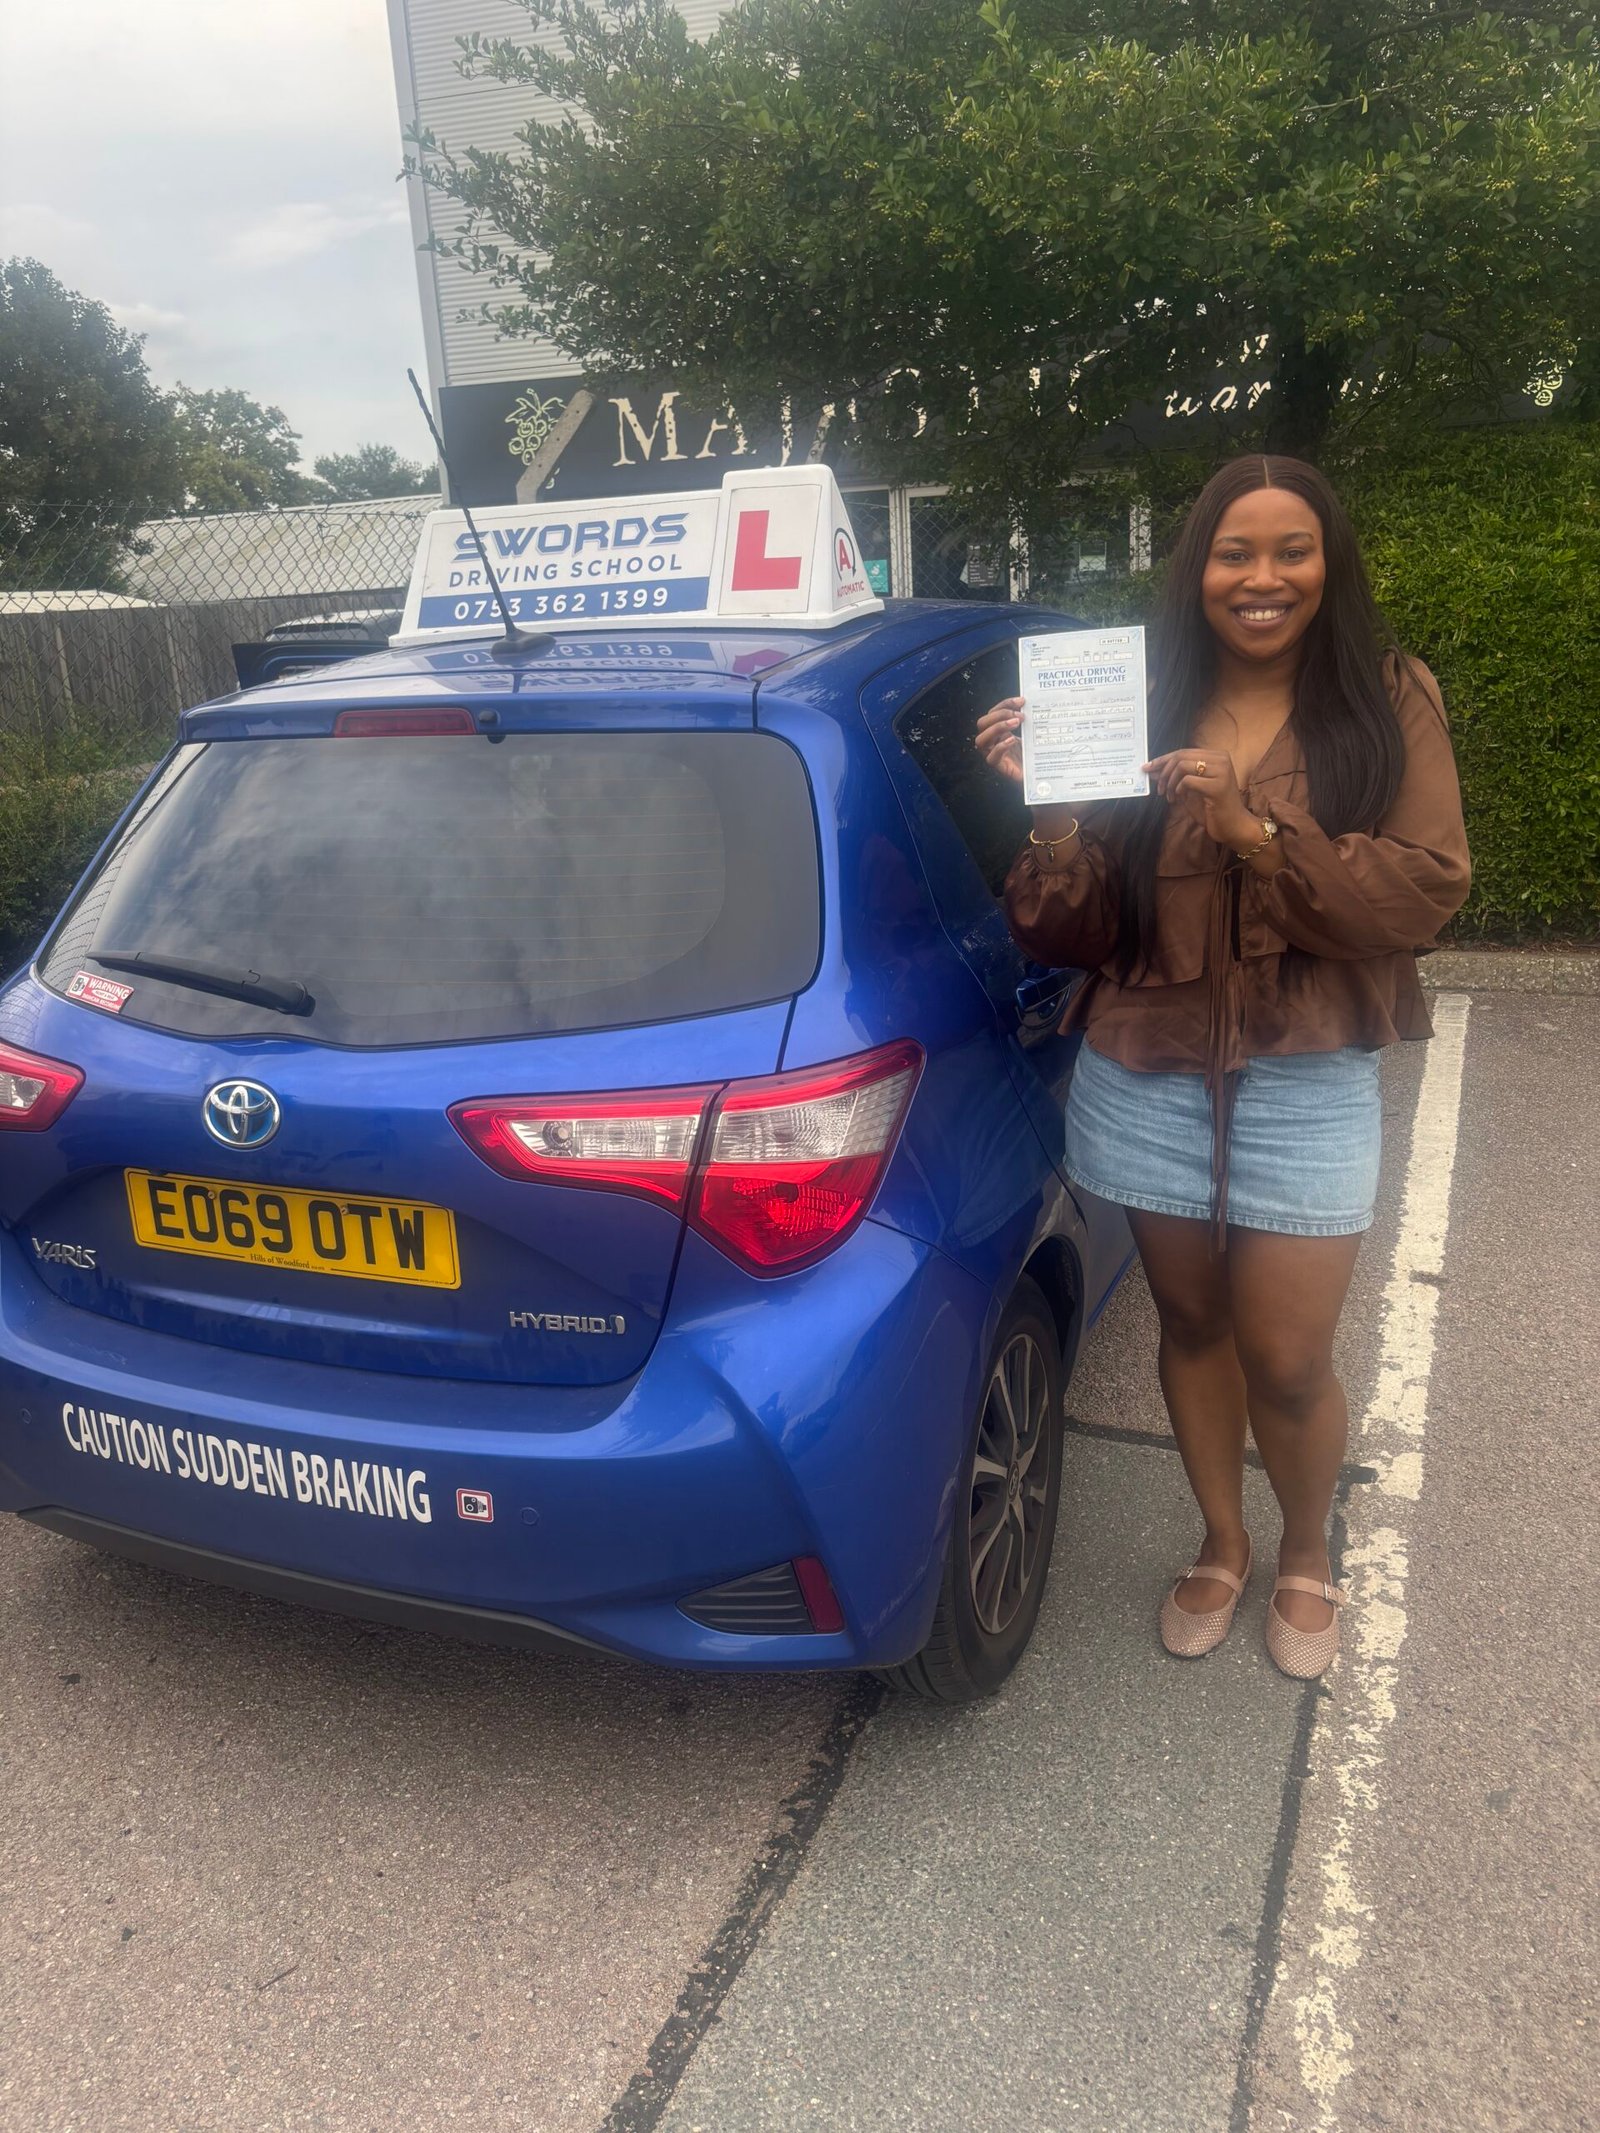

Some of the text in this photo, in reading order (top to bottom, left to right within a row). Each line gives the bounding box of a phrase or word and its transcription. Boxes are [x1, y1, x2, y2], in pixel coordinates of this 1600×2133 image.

[451, 513, 689, 563] SWORDS
[731, 509, 802, 591] L
[838, 538, 851, 571] A
[449, 554, 682, 588] DRVING SCHOOL
[837, 580, 865, 598] AUTOMATIC
[454, 587, 668, 620] 0753 362 1399
[1038, 665, 1126, 681] PRACTICAL DRIVING
[1039, 674, 1126, 689] TEST PASS CERTIFICATE
[88, 978, 130, 1000] WARNING
[250, 1253, 310, 1269] Hills of Woodford
[509, 1311, 606, 1333] HYBRID
[62, 1402, 432, 1524] CAUTION SUDDEN BRAKING
